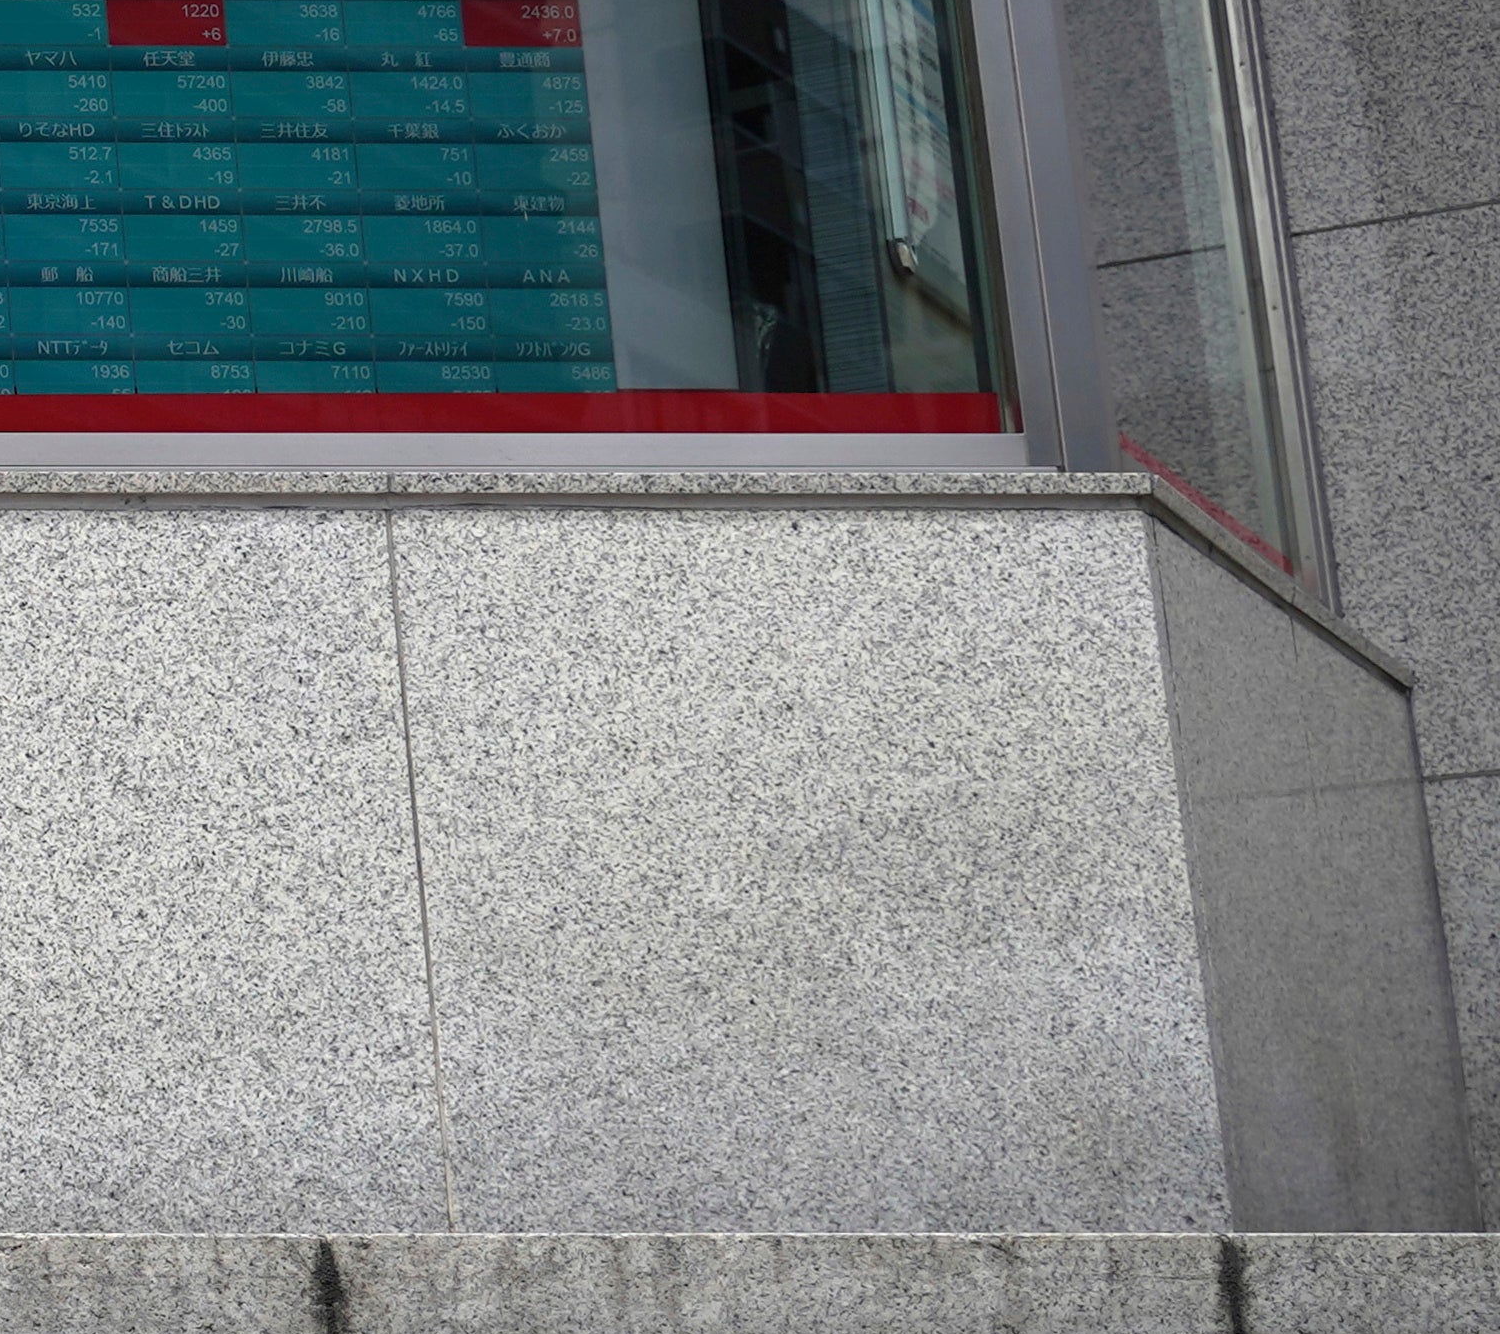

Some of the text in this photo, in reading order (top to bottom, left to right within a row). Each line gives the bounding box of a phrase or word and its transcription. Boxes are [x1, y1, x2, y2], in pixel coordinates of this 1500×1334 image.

[180, 2, 220, 18] 1220
[519, 4, 575, 19] 2436.0
[200, 26, 222, 41] +6
[541, 27, 578, 42] +7.0
[23, 48, 78, 66] ヤマハ
[141, 49, 196, 68] 任天堂
[67, 73, 107, 89] 5410
[176, 73, 226, 89] 57240
[72, 97, 109, 113] -260
[191, 97, 228, 113] -400
[151, 264, 223, 283] 商船三井
[204, 289, 245, 306] 3740
[219, 314, 247, 330] -30
